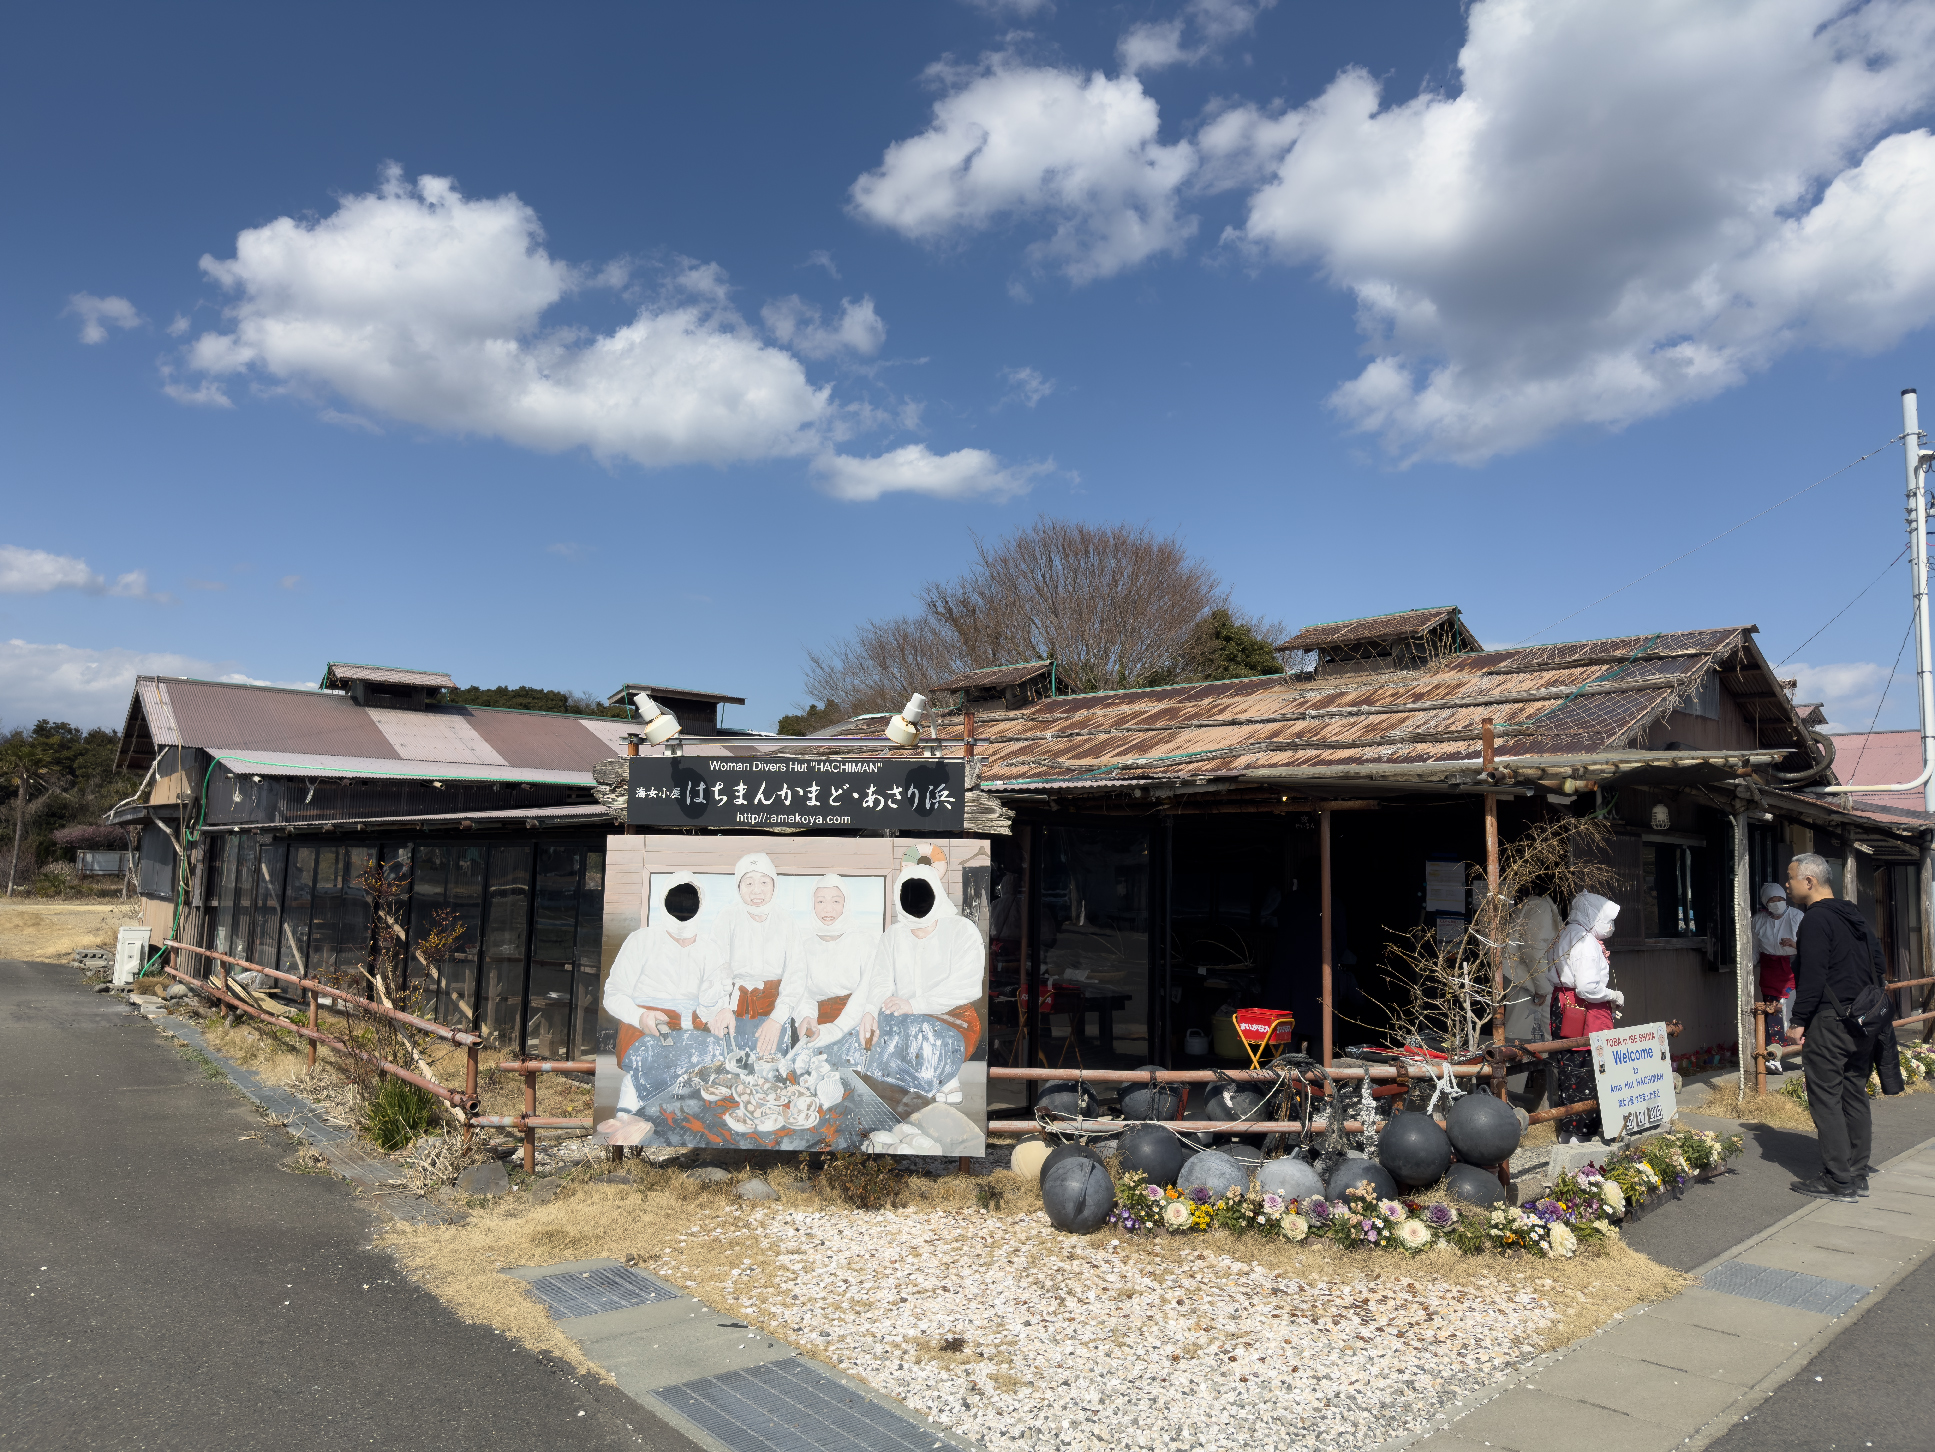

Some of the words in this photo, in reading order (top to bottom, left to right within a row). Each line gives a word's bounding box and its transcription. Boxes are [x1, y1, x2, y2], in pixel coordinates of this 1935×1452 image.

[709, 760, 750, 771] Woman
[752, 761, 787, 772] Divers
[789, 761, 807, 772] Hut
[810, 761, 883, 773] "HACHIMAN"
[635, 786, 681, 799] 海女小屋
[736, 811, 851, 826] http//:amakoya.com
[1606, 1036, 1622, 1047] TOBA
[1611, 1047, 1654, 1066] Welcome
